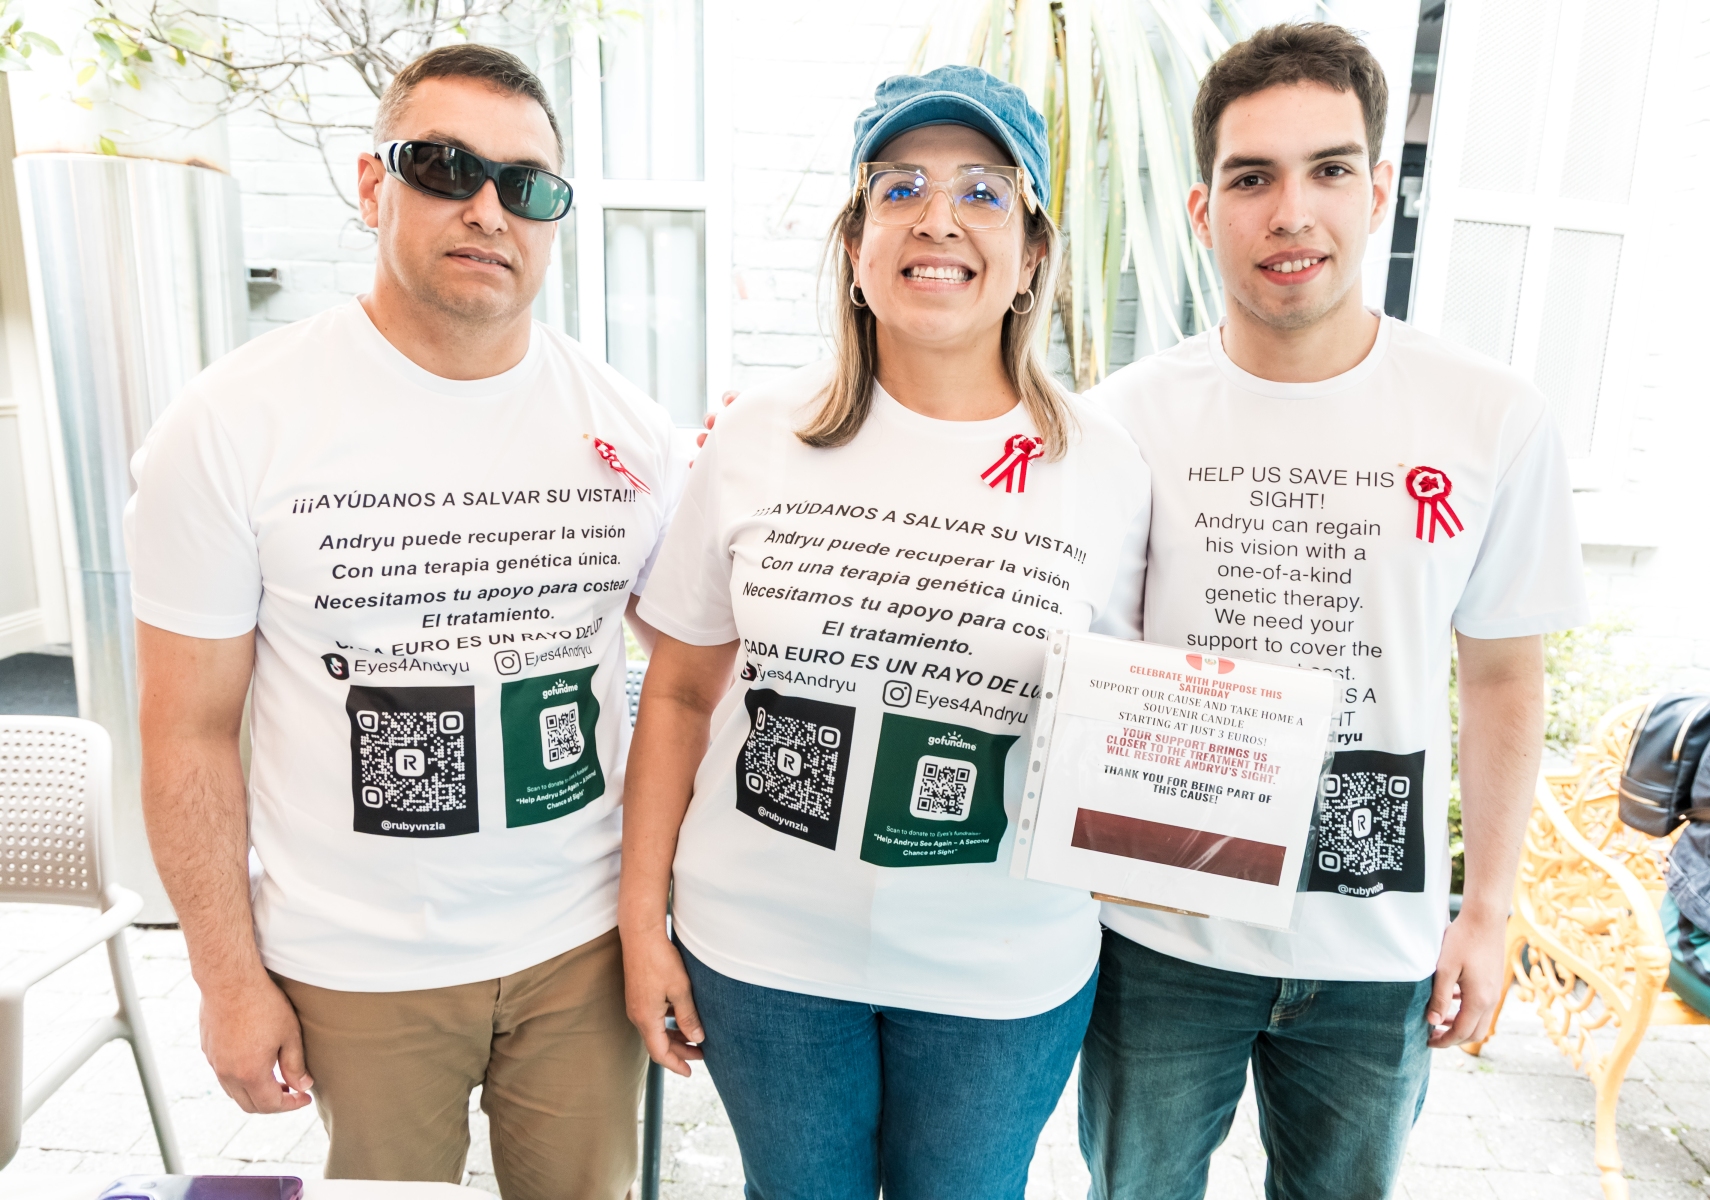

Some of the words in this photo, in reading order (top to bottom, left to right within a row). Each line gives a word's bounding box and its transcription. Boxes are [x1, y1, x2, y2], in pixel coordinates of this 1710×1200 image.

[1188, 466, 1244, 482] HELP
[1252, 467, 1282, 482] US
[1289, 469, 1348, 486] SAVE
[1356, 470, 1394, 488] HIS
[292, 491, 436, 514] ¡¡¡AYÚDANOS
[442, 493, 456, 507] A
[462, 490, 541, 506] SALVAR
[546, 489, 570, 503] SU
[576, 488, 637, 503] VISTA!!!
[1249, 490, 1325, 510] SIGHT!
[319, 533, 395, 552] Andryu
[401, 530, 462, 550] puede
[468, 527, 556, 548] recuperar
[561, 526, 576, 540] la
[581, 525, 626, 539] visión
[882, 509, 898, 523] A
[902, 512, 986, 536] SALVAR
[991, 525, 1018, 542] SU
[1024, 532, 1087, 565] VISTA!!!
[1194, 513, 1264, 534] Andryu
[1272, 518, 1308, 533] can
[1316, 519, 1381, 539] regain
[764, 530, 825, 549] Andryu
[827, 536, 891, 556] puede
[895, 546, 995, 571] recuperar
[1000, 559, 1016, 574] la
[1023, 566, 1070, 591] visión
[1206, 537, 1234, 553] his
[1240, 540, 1298, 557] vision
[1306, 542, 1346, 560] with
[1354, 548, 1367, 560] a
[332, 564, 374, 580] Con
[381, 564, 417, 577] una
[424, 558, 490, 577] terapia
[496, 554, 572, 574] genética
[578, 552, 621, 566] única.
[1218, 564, 1352, 584] one-of-a-kind
[314, 589, 447, 610] Necesitamos
[453, 587, 471, 602] tu
[477, 584, 534, 602] apoyo
[538, 580, 578, 597] para
[582, 578, 629, 594] costear
[760, 556, 794, 572] Con
[798, 561, 834, 576] una
[840, 564, 910, 590] terapia
[916, 570, 1005, 599] genética
[1011, 588, 1064, 615] única.
[742, 582, 854, 608] Necesitamos
[860, 597, 881, 611] tu
[887, 600, 954, 622] apoyo
[958, 608, 1006, 631] para
[1012, 621, 1049, 641] cos
[1204, 586, 1277, 604] genetic
[1284, 590, 1364, 612] therapy.
[422, 614, 440, 628] El
[446, 608, 555, 627] tratamiento.
[1214, 608, 1246, 625] We
[1253, 612, 1303, 630] need
[1310, 618, 1354, 634] your
[392, 639, 450, 657] EURO
[456, 636, 482, 649] ES
[488, 633, 515, 645] UN
[521, 630, 572, 642] RAYO
[822, 620, 844, 638] El
[850, 626, 974, 656] tratamiento.
[1187, 634, 1258, 651] support
[1264, 637, 1282, 653] to
[1290, 641, 1346, 657] cover
[1352, 640, 1382, 658] the
[354, 657, 470, 676] Eyes4Andryu
[744, 638, 779, 659] CADA
[784, 646, 844, 666] EURO
[850, 652, 879, 670] ES
[886, 657, 918, 676] UN
[922, 664, 984, 689] RAYO
[986, 675, 1018, 698] DE
[1019, 682, 1042, 699] LU
[542, 683, 578, 700] gofundme
[1130, 665, 1182, 682] CELEBRATE
[1185, 674, 1209, 686] WITH
[1212, 679, 1258, 696] PURPOSE
[1260, 688, 1282, 700] THIS
[1179, 682, 1230, 699] SATURDAY
[1362, 688, 1377, 703] A
[915, 688, 1029, 725] Eyes4Andryu
[1090, 678, 1140, 696] SUPPORT
[1142, 688, 1165, 700] OUR
[1167, 692, 1202, 708] CAUSE
[1203, 699, 1228, 712] AND
[1230, 704, 1258, 718] TAKE
[1260, 710, 1294, 724] HOME
[1296, 717, 1304, 726] A
[1142, 702, 1198, 720] SOUVENIR
[1200, 713, 1244, 728] CANDLE
[1118, 712, 1172, 728] STARTING
[1174, 722, 1188, 732] AT
[1190, 724, 1216, 738] JUST
[1218, 730, 1224, 738] 3
[1227, 732, 1268, 746] EUROS!
[928, 735, 977, 752] gofundme
[1106, 735, 1146, 750] CLOSER
[1150, 742, 1164, 753] TO
[1167, 746, 1186, 757] THE
[1190, 750, 1250, 768] TREATMENT
[1254, 762, 1281, 774] THAT
[1123, 728, 1151, 740] YOUR
[1155, 734, 1206, 750] SUPPORT
[1208, 744, 1250, 758] BRINGS
[1253, 752, 1268, 762] US
[1106, 745, 1131, 757] WILL
[1134, 750, 1180, 766] RESTORE
[1241, 770, 1276, 784] SIGHT.
[536, 792, 559, 802] Andryu
[1104, 765, 1138, 779] THANK
[1142, 772, 1164, 784] YOU
[1167, 776, 1188, 788] FOR
[1191, 780, 1223, 794] BEING
[1226, 788, 1256, 800] PART
[1258, 794, 1272, 804] OF
[1153, 784, 1177, 796] THIS
[1180, 789, 1218, 804] CAUSE!
[381, 820, 446, 832] @rubyvnzla
[758, 806, 809, 834] @rubyvnzla
[886, 826, 900, 834] Scan
[893, 839, 918, 848] Andryu
[934, 840, 952, 848] Again
